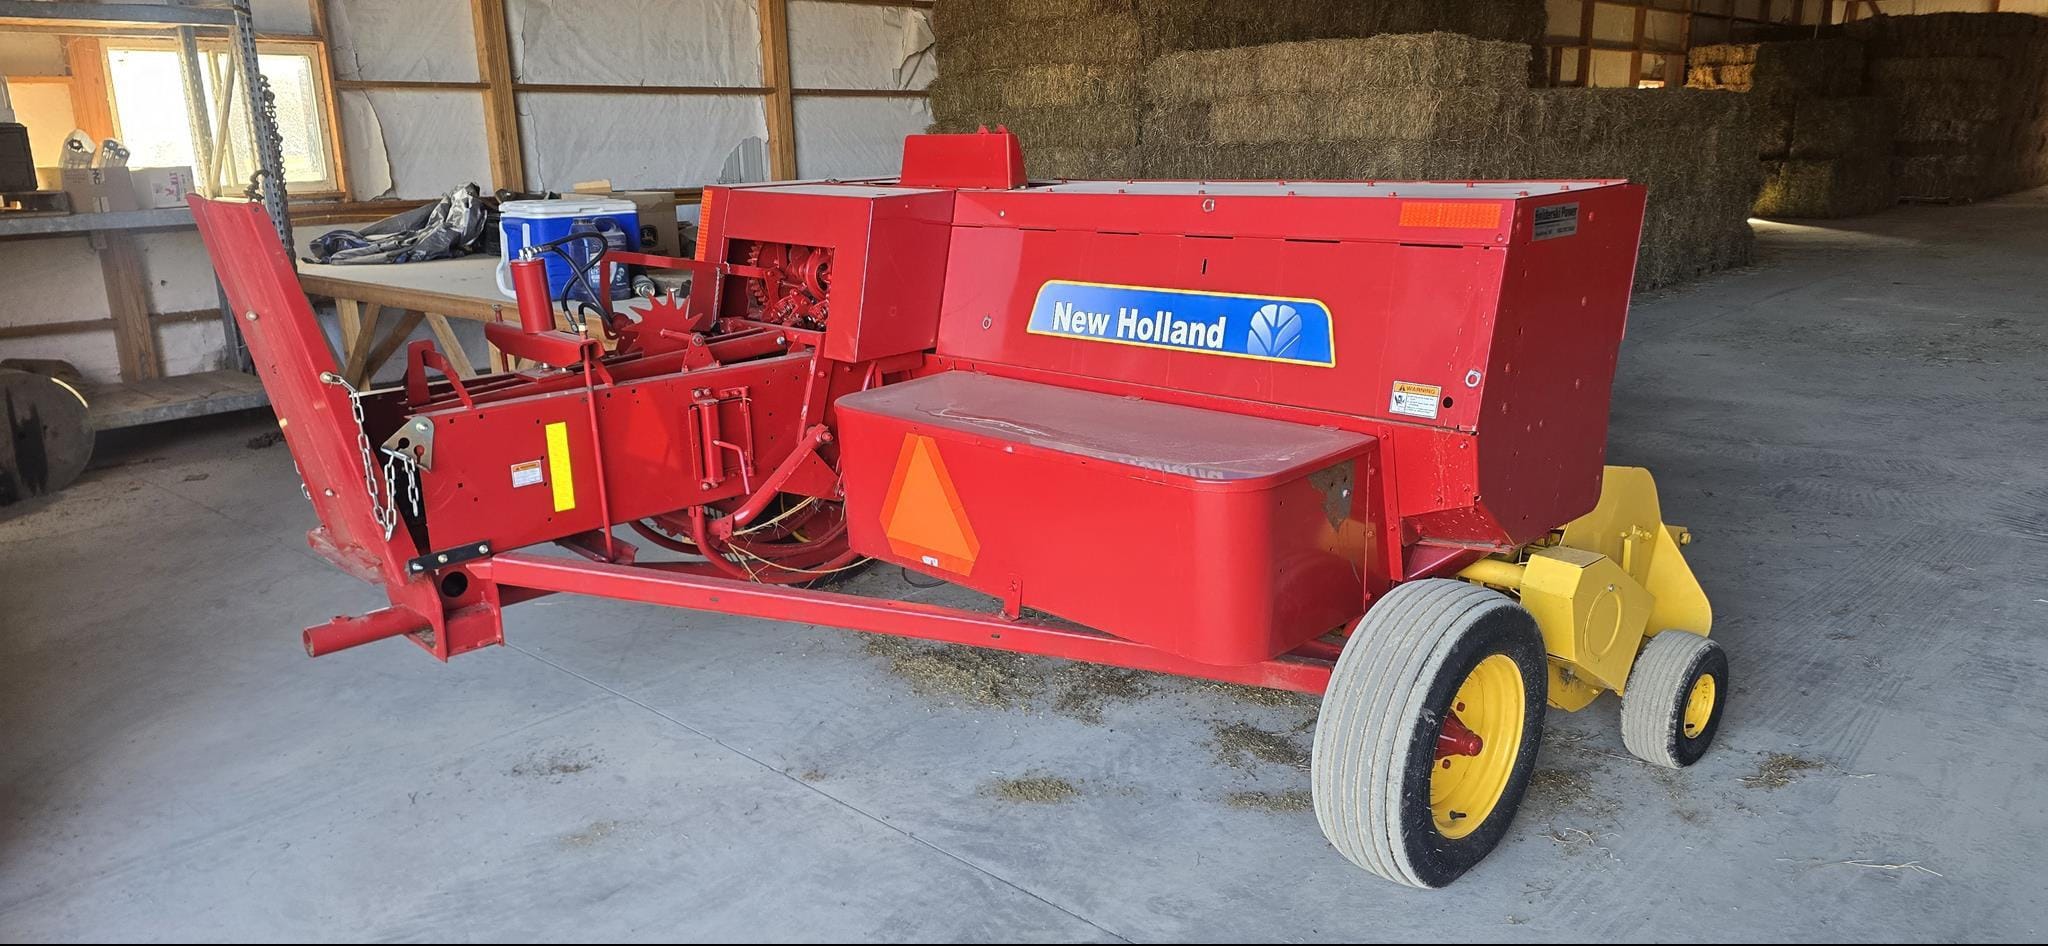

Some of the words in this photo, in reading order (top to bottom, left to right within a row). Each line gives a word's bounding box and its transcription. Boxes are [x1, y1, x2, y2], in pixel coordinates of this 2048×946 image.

[1053, 302, 1110, 335] New
[1117, 308, 1226, 348] Holland
[1406, 386, 1436, 395] WARNING
